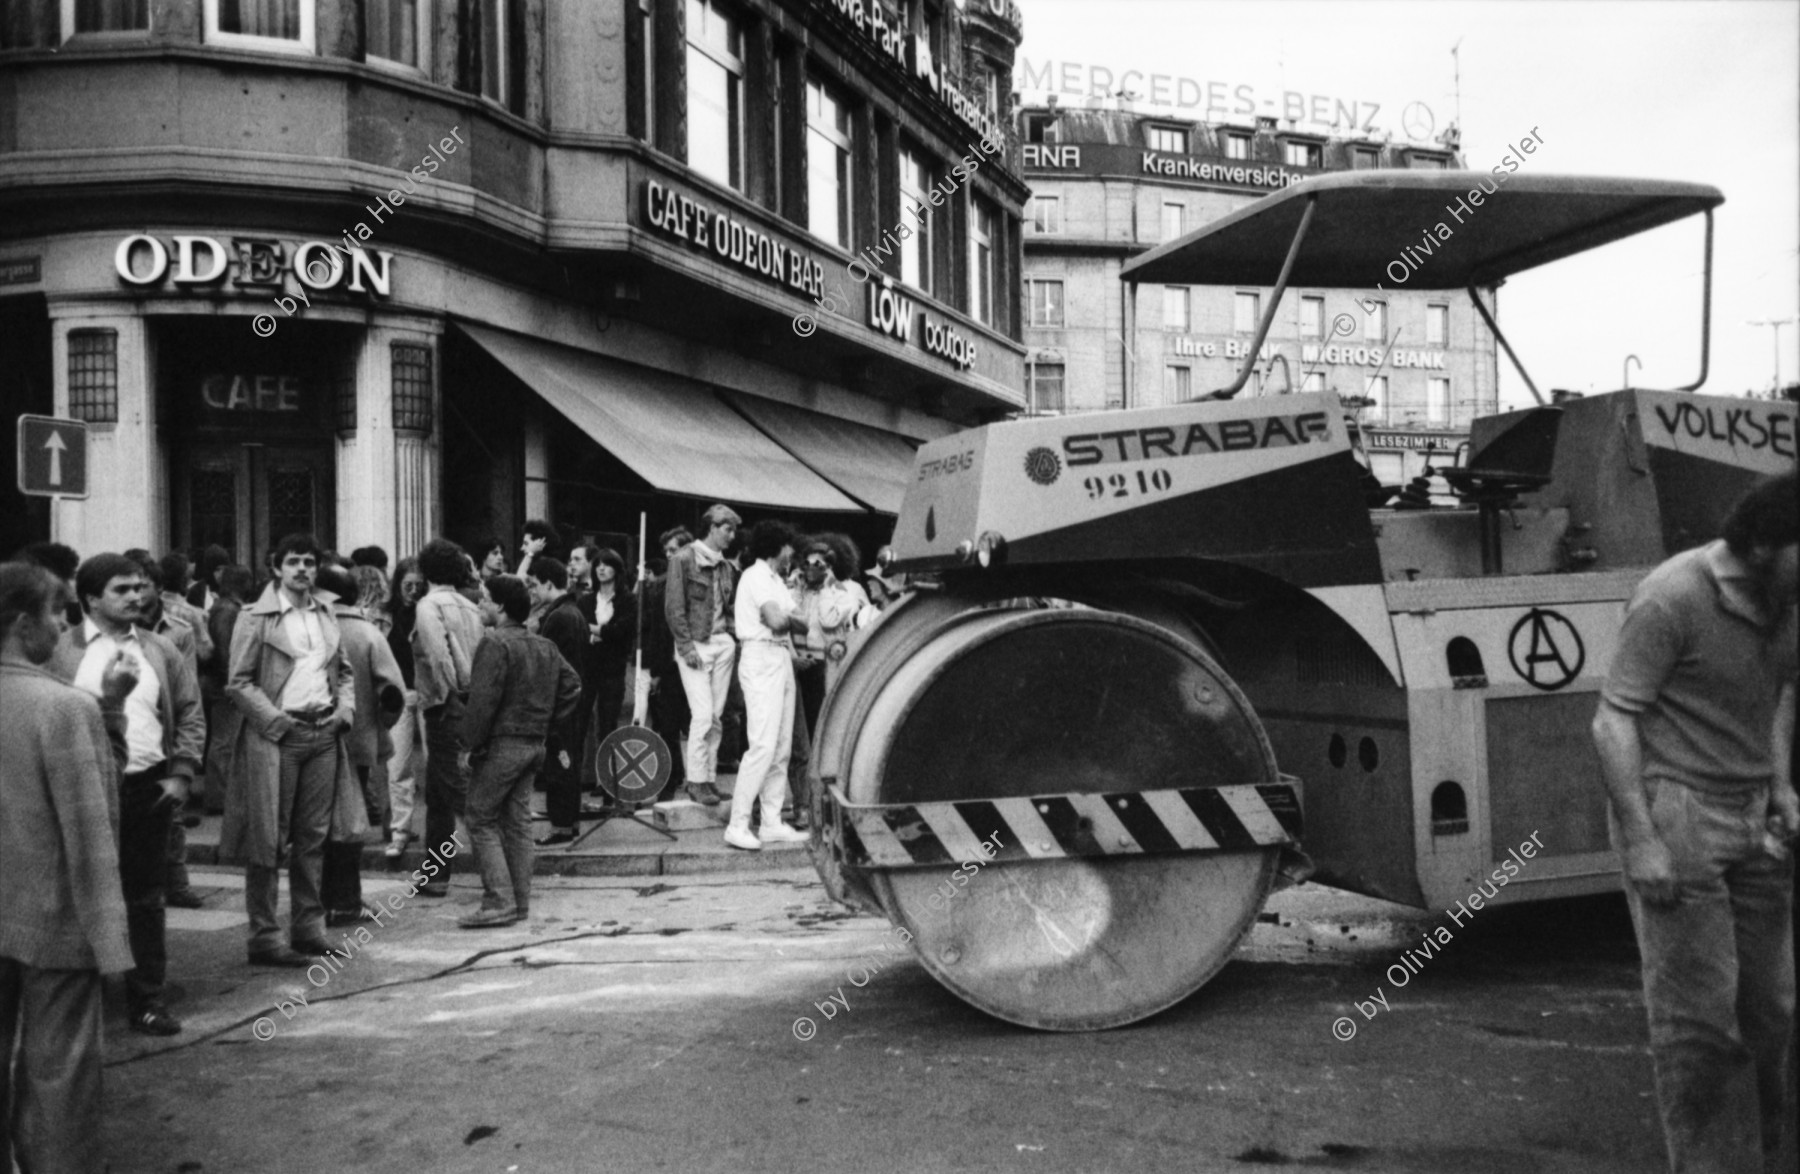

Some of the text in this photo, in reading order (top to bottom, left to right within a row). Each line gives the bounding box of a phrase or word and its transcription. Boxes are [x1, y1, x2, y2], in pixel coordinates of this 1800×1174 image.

[832, 0, 907, 69] ova-Park
[1019, 56, 1381, 134] MERCEDES-BENZ
[115, 234, 394, 296] ODEON
[647, 179, 825, 298] CAFE ODEON BAR
[925, 313, 976, 371] boutique
[1175, 337, 1216, 357] Ihre
[1302, 344, 1384, 367] MIGROS
[1393, 350, 1445, 369] BANK
[202, 373, 300, 412] CAFE
[1655, 402, 1799, 459] VOLKSE
[918, 450, 975, 481] STRABAG
[1084, 468, 1172, 499] 9210
